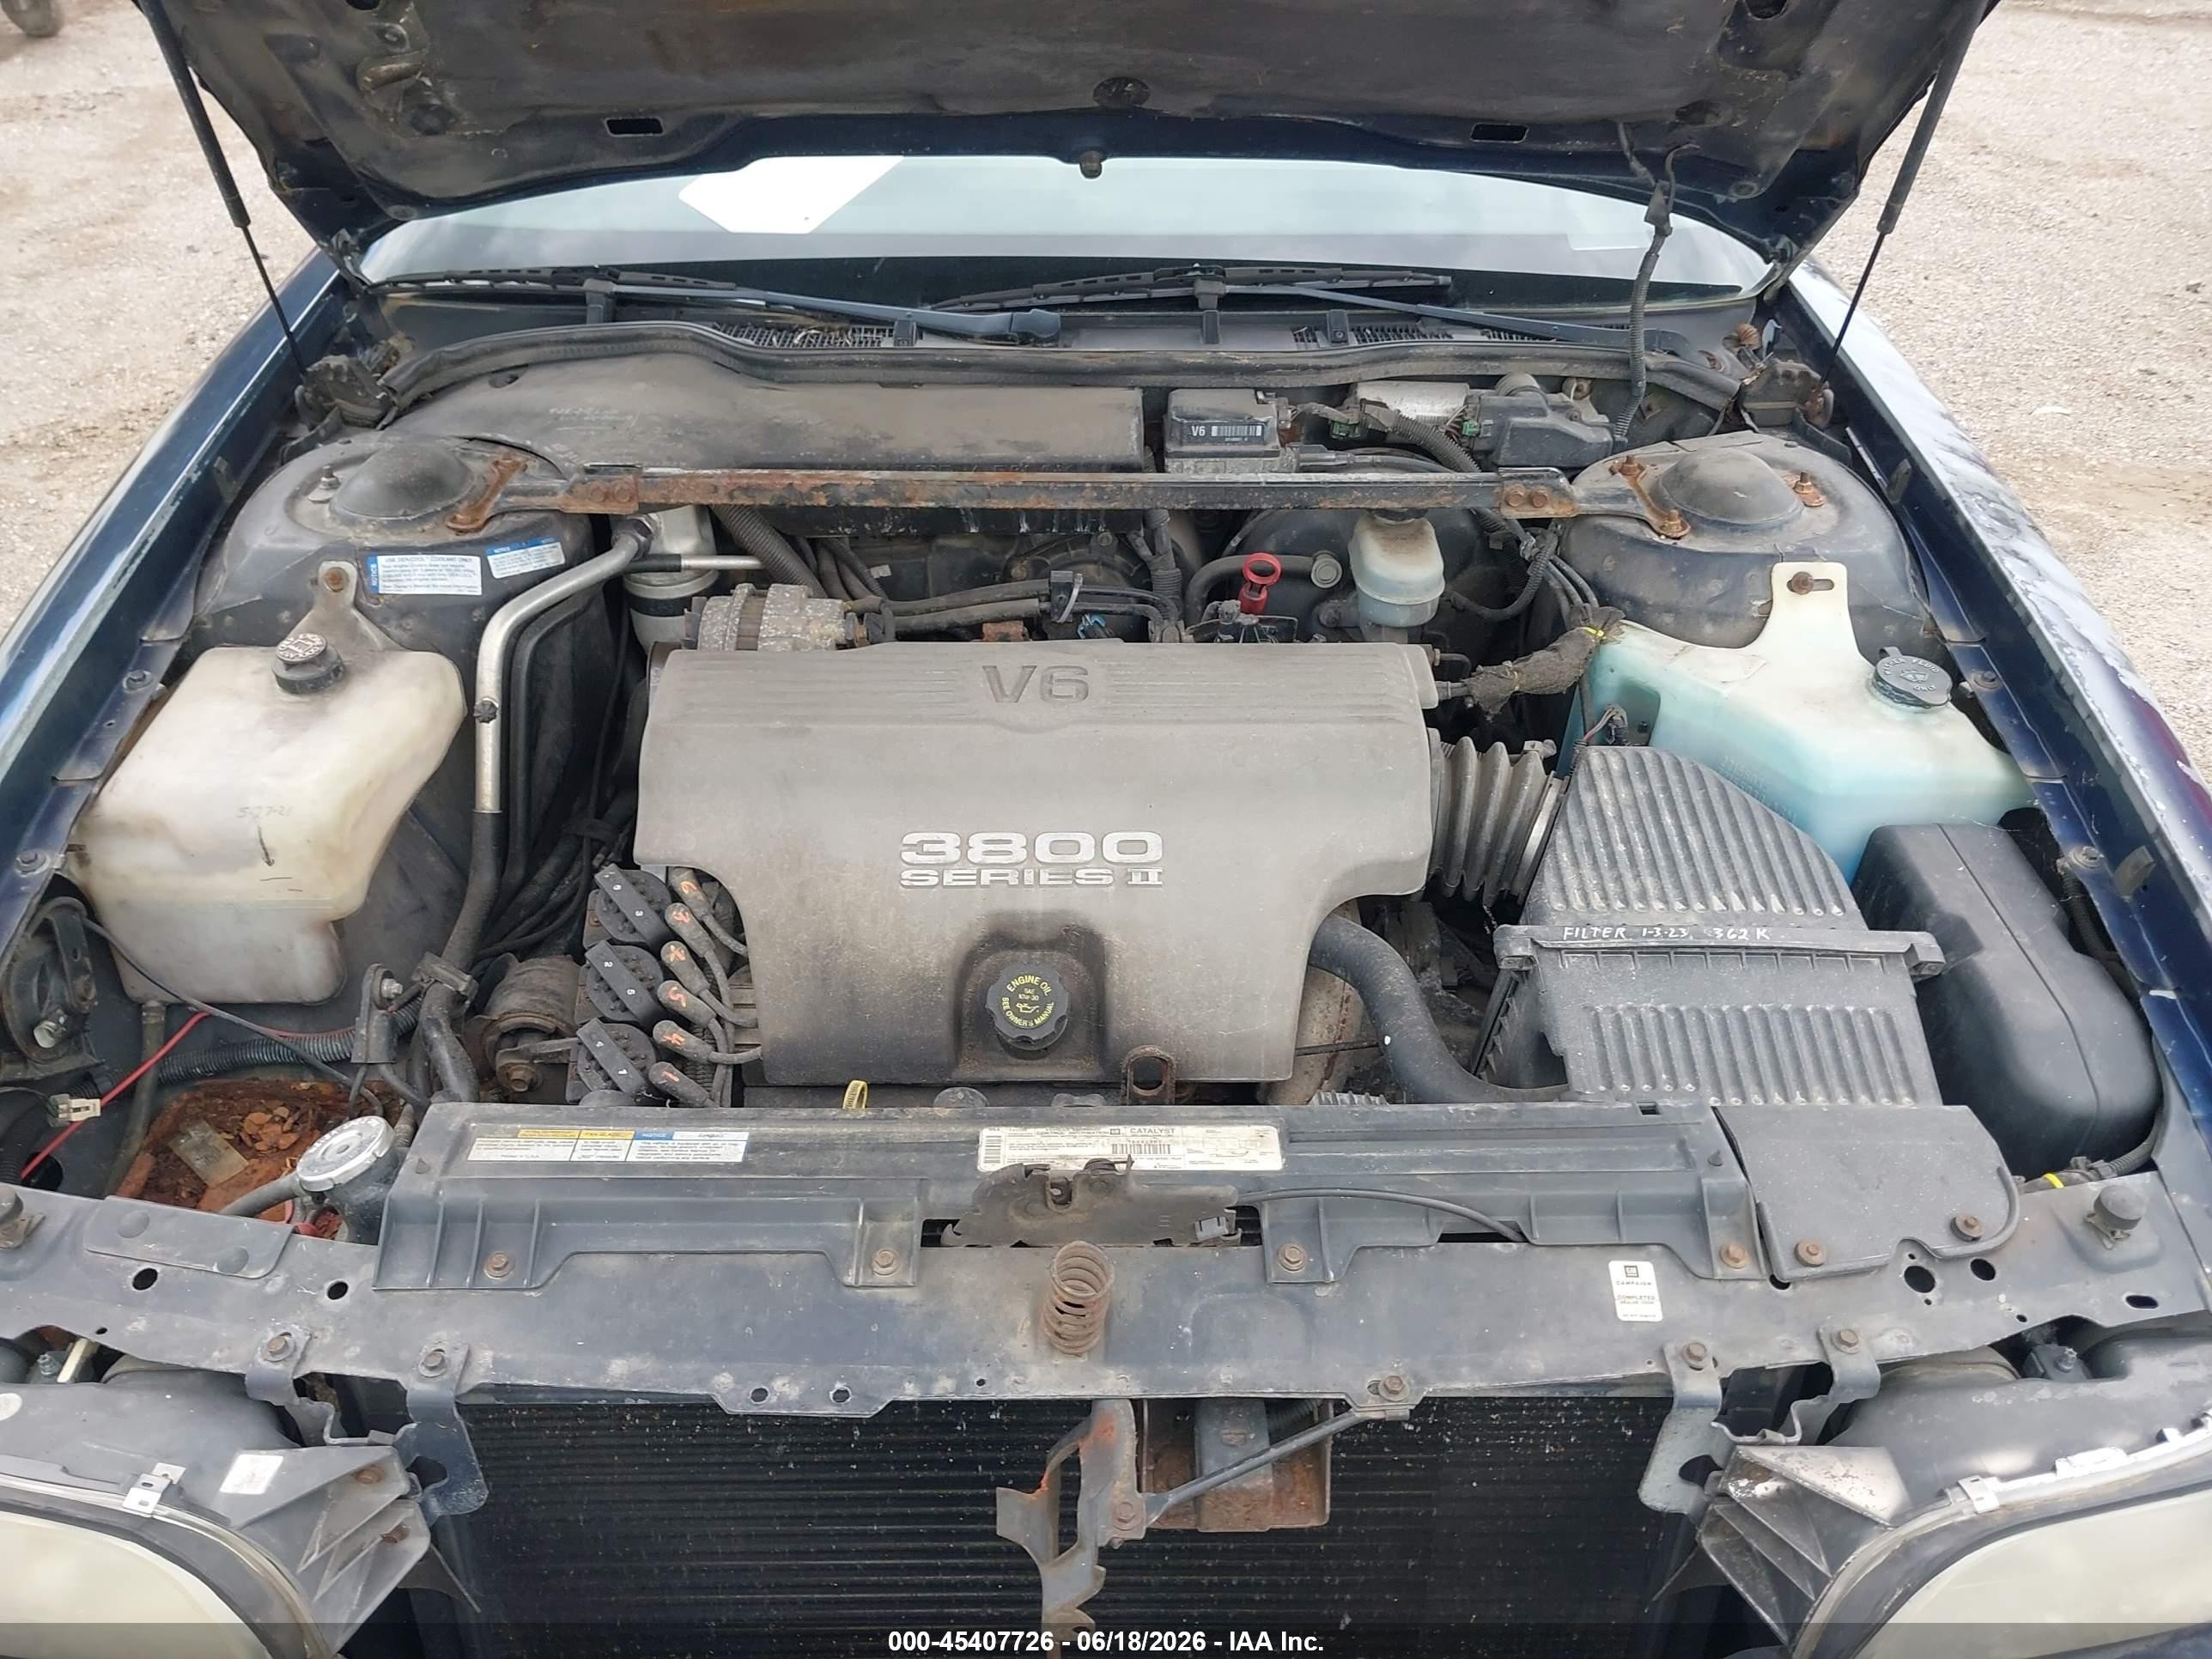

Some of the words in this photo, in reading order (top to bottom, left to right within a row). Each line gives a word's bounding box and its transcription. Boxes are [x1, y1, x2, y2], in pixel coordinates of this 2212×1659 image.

[1191, 425, 1206, 436] V6
[981, 665, 1089, 703] V6
[902, 831, 1163, 865] 3800
[900, 867, 1114, 887] SERIES
[1127, 867, 1163, 887] II
[1563, 926, 1627, 940] FILTER
[1756, 927, 1771, 940] K
[1006, 975, 1042, 993] ENGINE
[1040, 981, 1053, 996] OIL
[1001, 997, 1011, 1011] SEE
[1034, 1001, 1055, 1025] MANUAL
